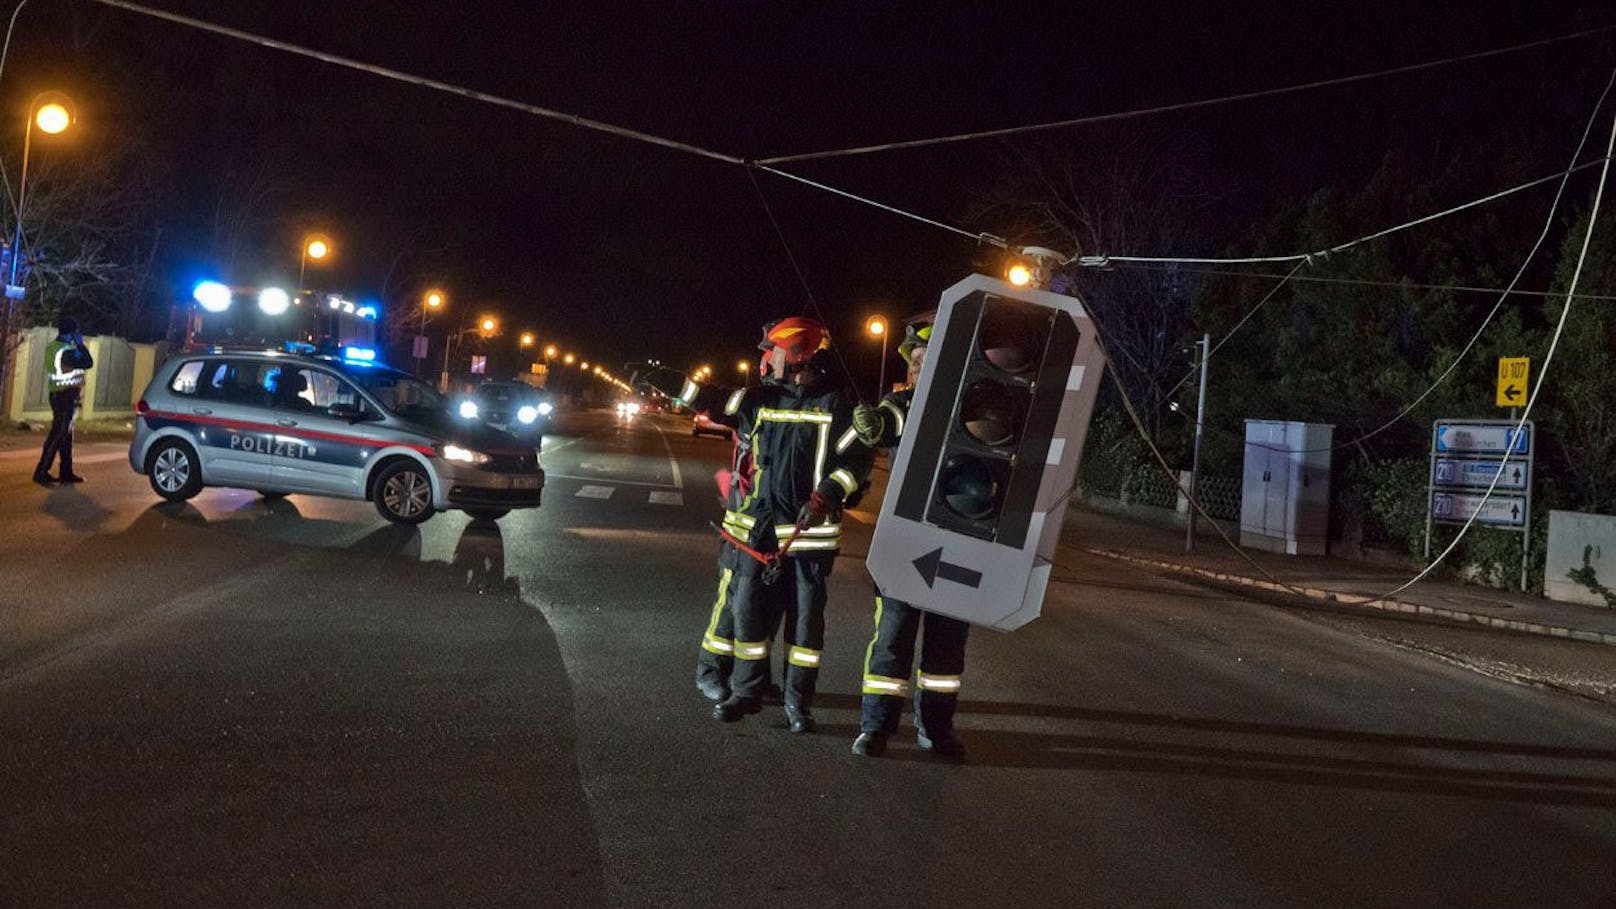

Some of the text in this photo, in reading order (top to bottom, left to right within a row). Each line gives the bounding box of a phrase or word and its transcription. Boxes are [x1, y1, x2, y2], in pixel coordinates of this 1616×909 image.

[1501, 361, 1527, 380] U 107
[230, 435, 304, 458] POLIZEI
